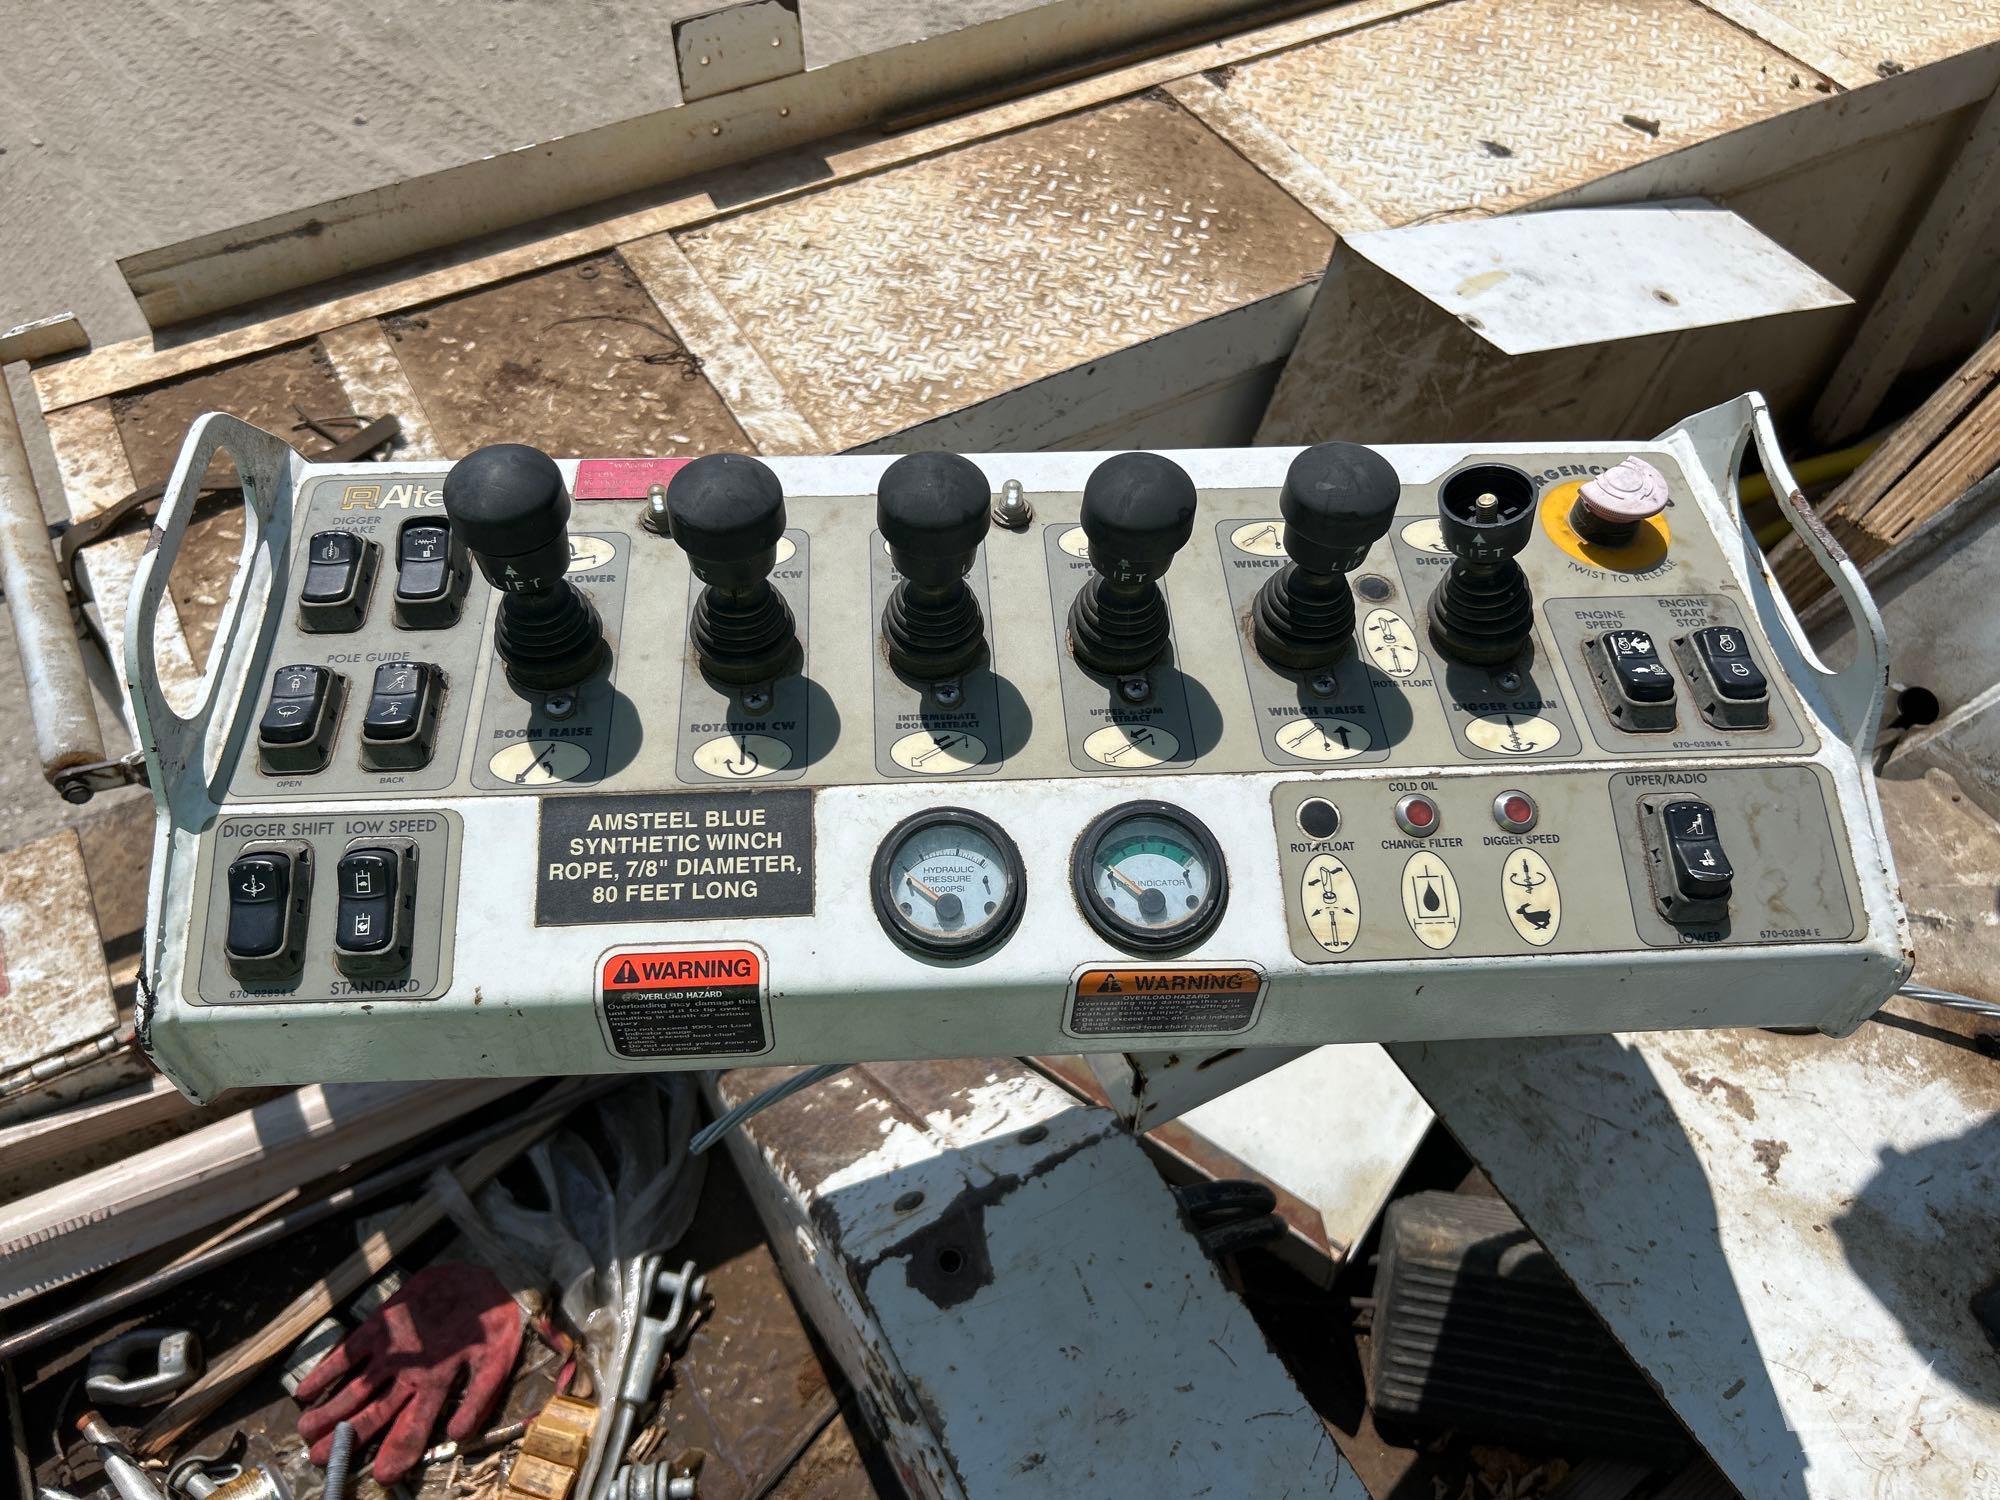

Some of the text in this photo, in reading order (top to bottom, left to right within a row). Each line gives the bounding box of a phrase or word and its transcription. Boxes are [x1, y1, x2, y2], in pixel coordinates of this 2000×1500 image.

[1533, 464, 1608, 487] RGENC
[377, 484, 445, 509] Alte
[332, 516, 382, 525] DIGGER
[1456, 544, 1505, 558] LIFT
[1233, 560, 1279, 568] WINCH
[1331, 559, 1362, 572] LIF
[1416, 557, 1456, 565] DIGG
[773, 570, 803, 579] CCW
[1568, 557, 1678, 583] TWIST TO RELEASE
[491, 577, 541, 591] LIFT
[568, 574, 616, 583] LOWER
[1658, 599, 1708, 608] ENGINE
[1574, 610, 1625, 620] ENGINE
[1669, 608, 1704, 617] START
[1585, 620, 1623, 629] SPEED
[1676, 617, 1708, 627] STOP
[327, 651, 410, 663] POLE GUIDE
[1373, 679, 1434, 689] ROTA FLOAT
[1267, 704, 1367, 716] WINCH RAISE
[1452, 700, 1558, 712] DIGGER CLEAN
[898, 712, 977, 721] INTERMEDIATE
[1090, 708, 1125, 716] UPPER
[1105, 715, 1151, 723] RETRACT
[690, 721, 796, 733] ROTATION CW
[896, 720, 980, 730] BOOM RETRACT
[493, 726, 593, 739] BOOM RAISE
[1673, 740, 1723, 749] 670-02894
[276, 780, 302, 788] OPEN
[379, 775, 404, 785] BACK
[1625, 773, 1708, 788] UPPER/RADIO
[1388, 781, 1438, 792] COLD OIL
[587, 809, 766, 831] AMSTEEL BLUE
[223, 819, 437, 838] DIGGER SHIFT LOW SPEED
[569, 831, 782, 856] SYNTHETIC WINCH
[1381, 837, 1464, 850] CHANGE FILTER
[1483, 834, 1560, 846] DIGGER SPEED
[1322, 841, 1355, 852] FLOAT
[549, 855, 802, 882] ROPE, 7/8" DIAMETER,
[923, 865, 975, 874] HYDRAULIC
[923, 874, 972, 883] PRESSURE
[1137, 879, 1186, 888] INDICATOR
[592, 880, 758, 904] 80 FEET LONG
[1678, 931, 1722, 944] LOWER
[1760, 928, 1821, 939] 670-02894 E
[641, 958, 751, 981] WARNING
[330, 978, 420, 996] STANDARD
[1134, 974, 1243, 991] WARNING
[637, 990, 723, 1001] OVERLOAD HAZARD
[607, 1002, 667, 1010] Overloading
